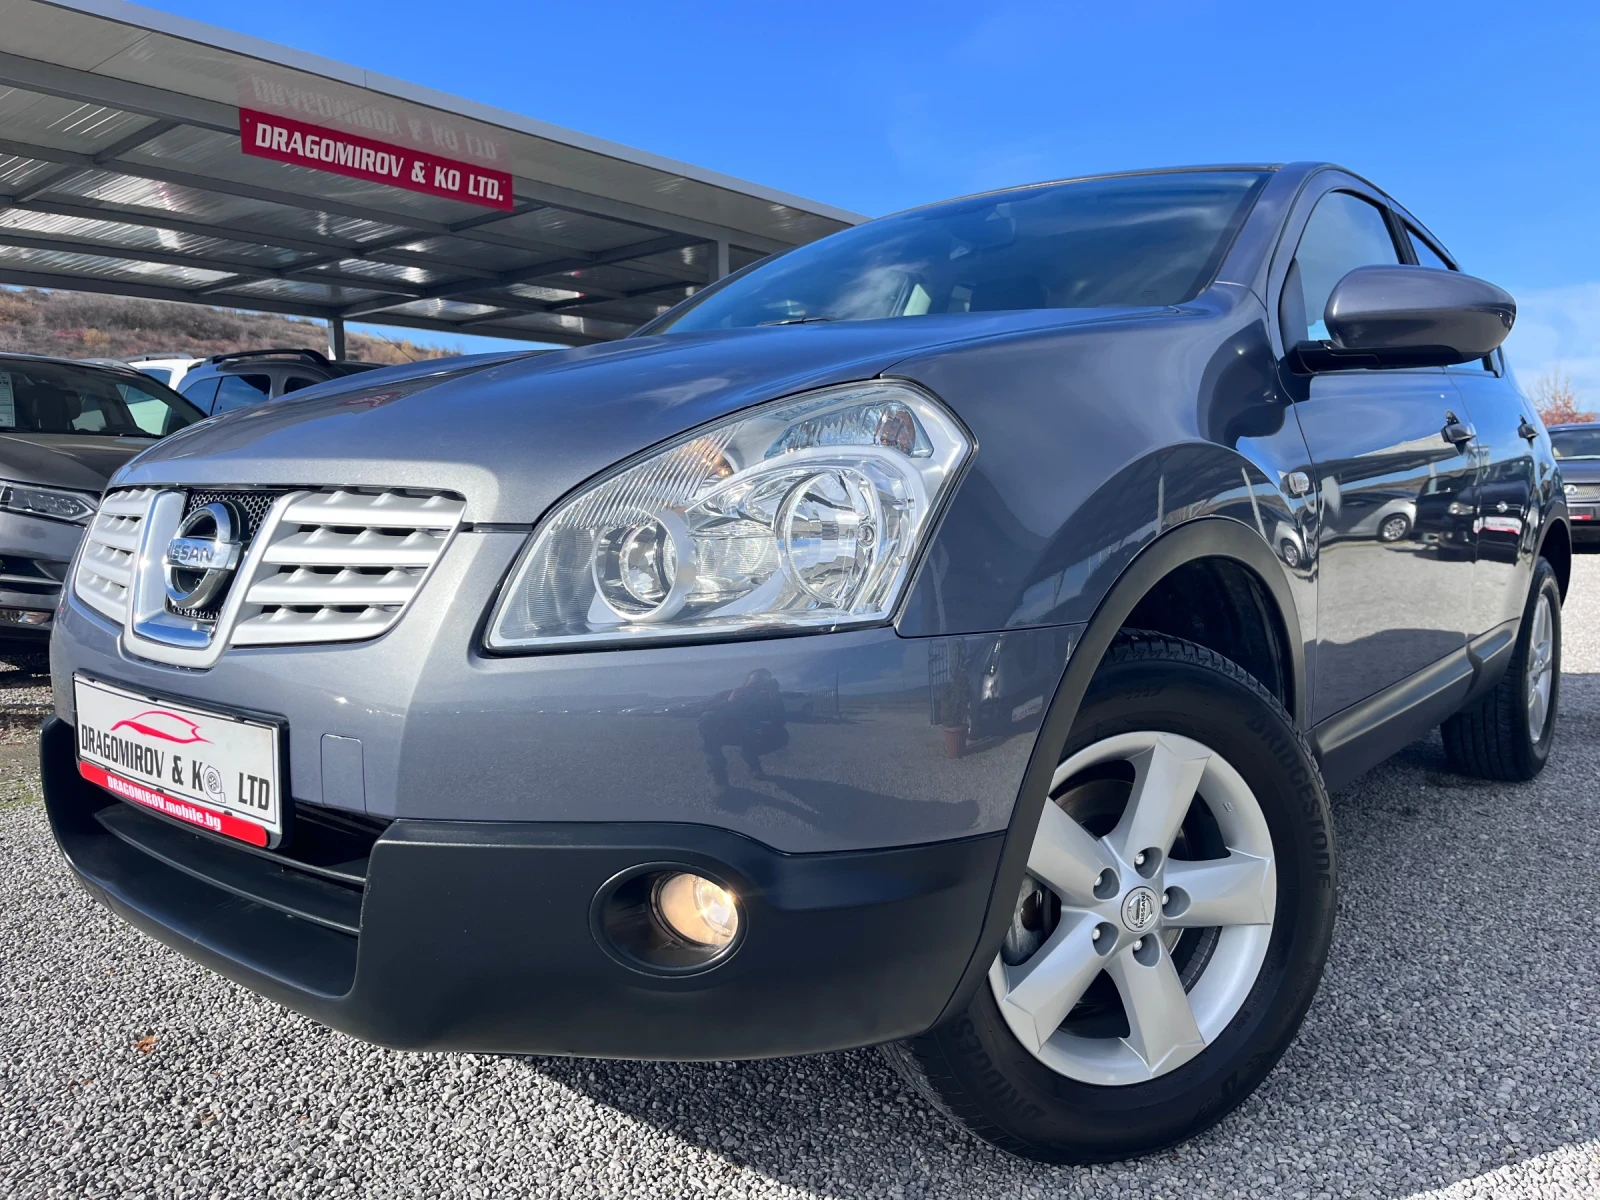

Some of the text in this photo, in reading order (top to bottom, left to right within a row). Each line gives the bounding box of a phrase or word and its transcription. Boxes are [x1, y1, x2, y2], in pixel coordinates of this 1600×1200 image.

[255, 122, 504, 202] DRAGOMIROV & KO LTD.
[81, 724, 165, 779] DRAGOMIROV
[171, 754, 184, 786] &
[237, 771, 270, 811] LTD
[107, 775, 222, 831] DRAGOMIROV.mobile.bg
